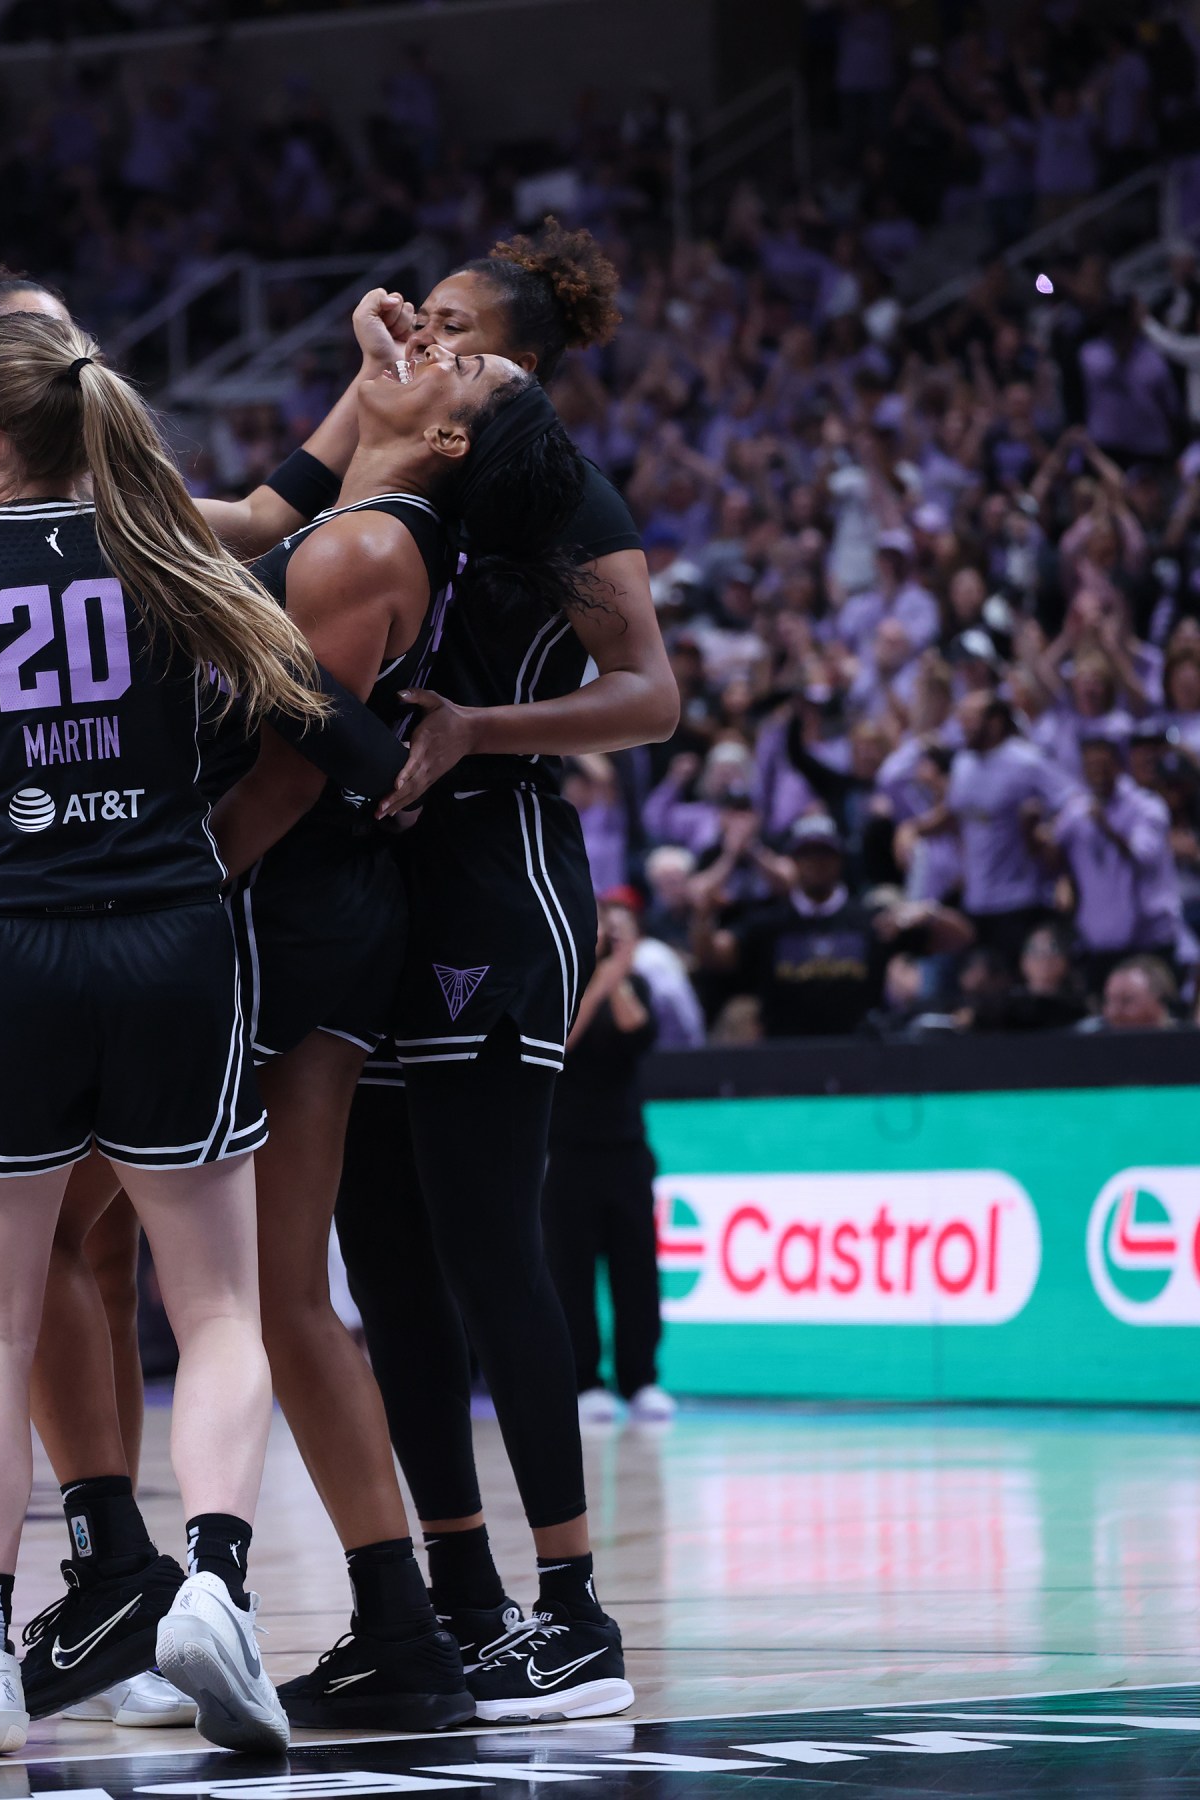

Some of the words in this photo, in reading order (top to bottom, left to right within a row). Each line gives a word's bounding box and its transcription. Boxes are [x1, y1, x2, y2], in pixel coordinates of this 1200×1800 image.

[23, 716, 121, 767] MARTIN
[62, 788, 145, 824] AT&T
[721, 1204, 1000, 1294] Castrol
